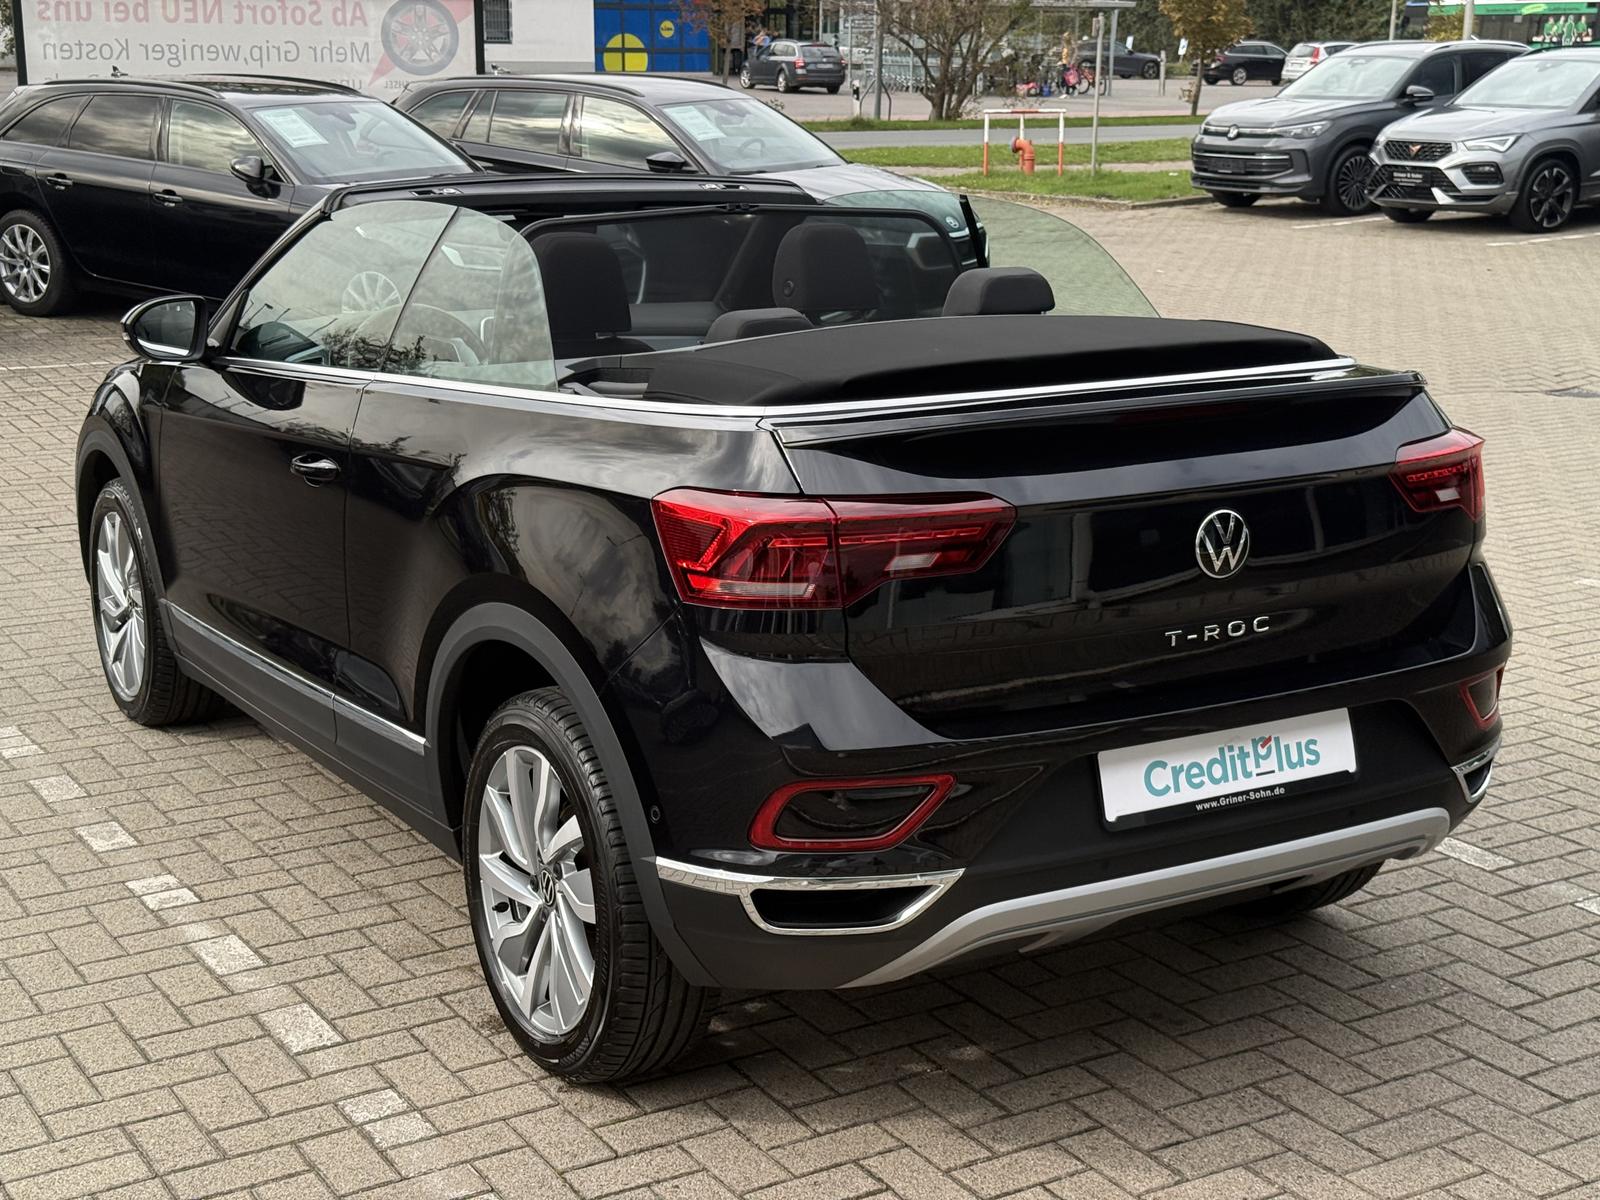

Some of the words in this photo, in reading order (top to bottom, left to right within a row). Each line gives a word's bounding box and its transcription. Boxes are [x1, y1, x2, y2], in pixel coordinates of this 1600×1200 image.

[1164, 615, 1271, 647] T-ROC
[1143, 734, 1321, 798] CreditPlus
[1195, 786, 1286, 811] www.Griner-Sohn.de
